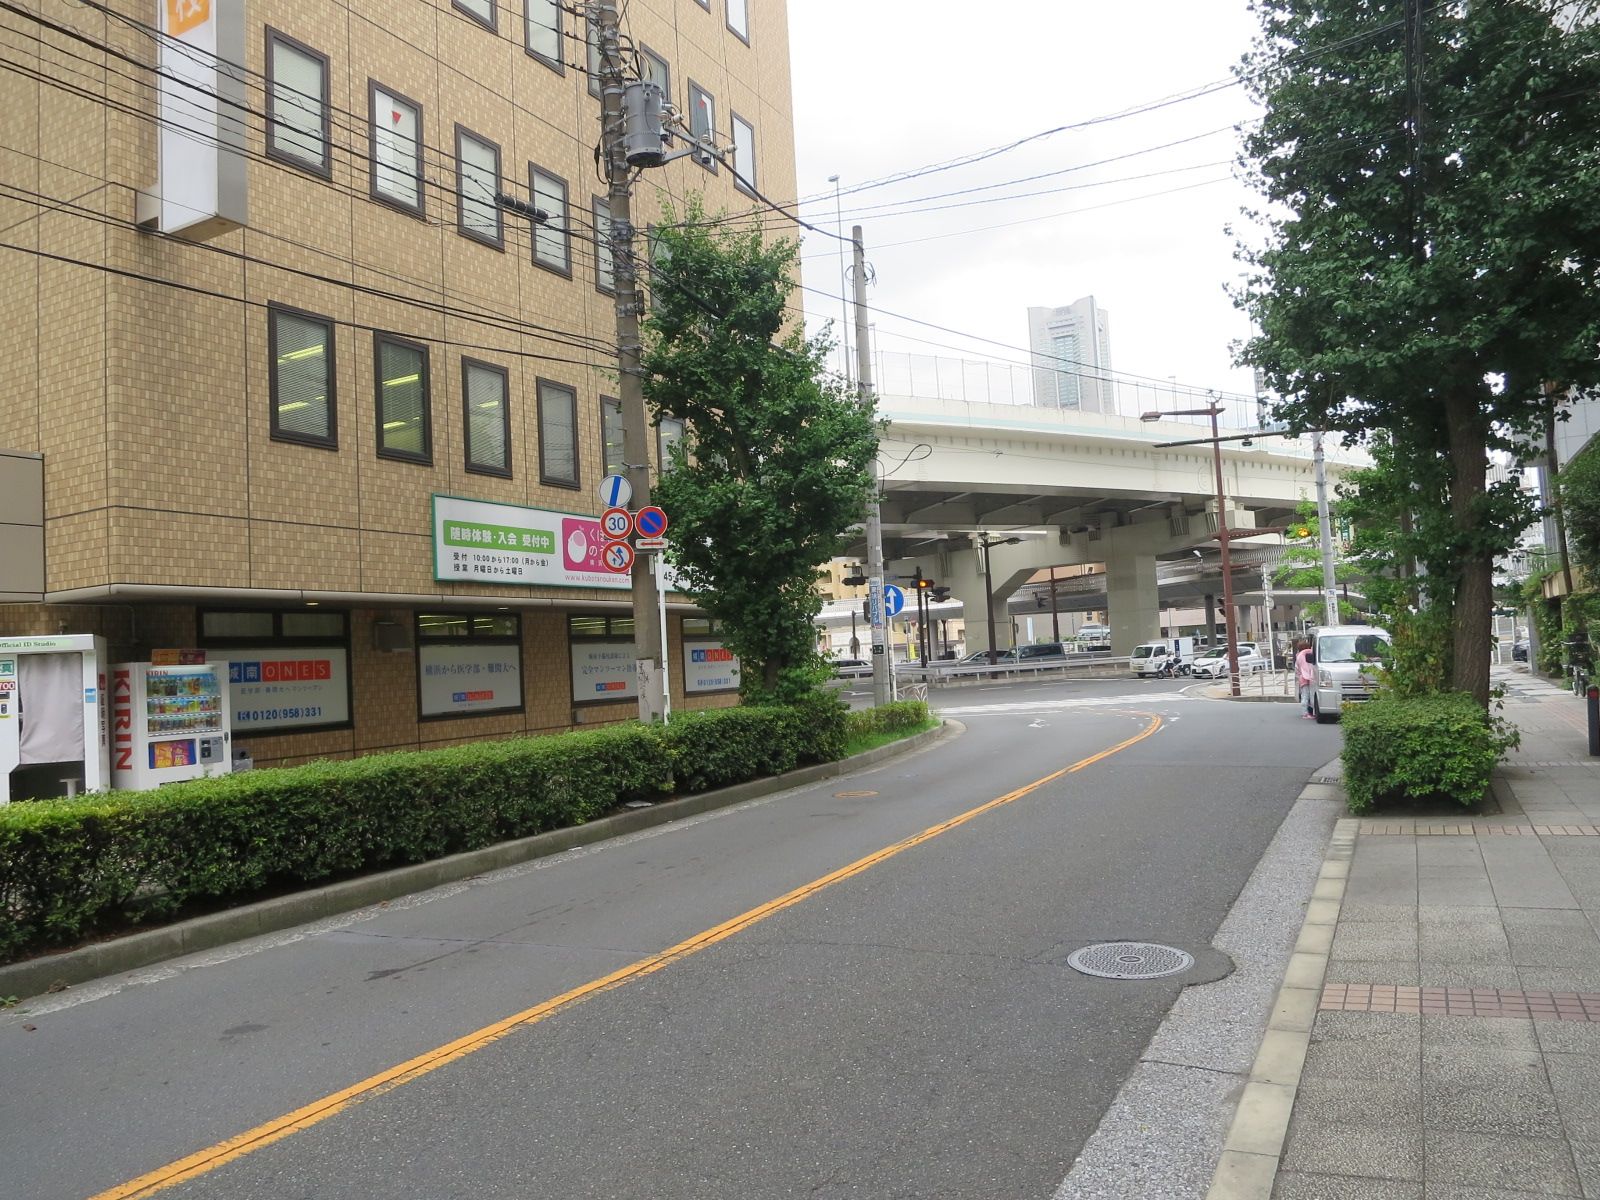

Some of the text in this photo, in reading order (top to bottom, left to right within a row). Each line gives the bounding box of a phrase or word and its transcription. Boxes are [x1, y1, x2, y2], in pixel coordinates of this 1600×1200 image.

[608, 517, 626, 531] 30
[450, 526, 550, 548] 随時体験・入会 受付中
[453, 552, 468, 561] 受付
[453, 563, 523, 575] 授業 月曜日から土曜日
[114, 670, 132, 770] KIRIN
[252, 707, 322, 720] 0120(958)331
